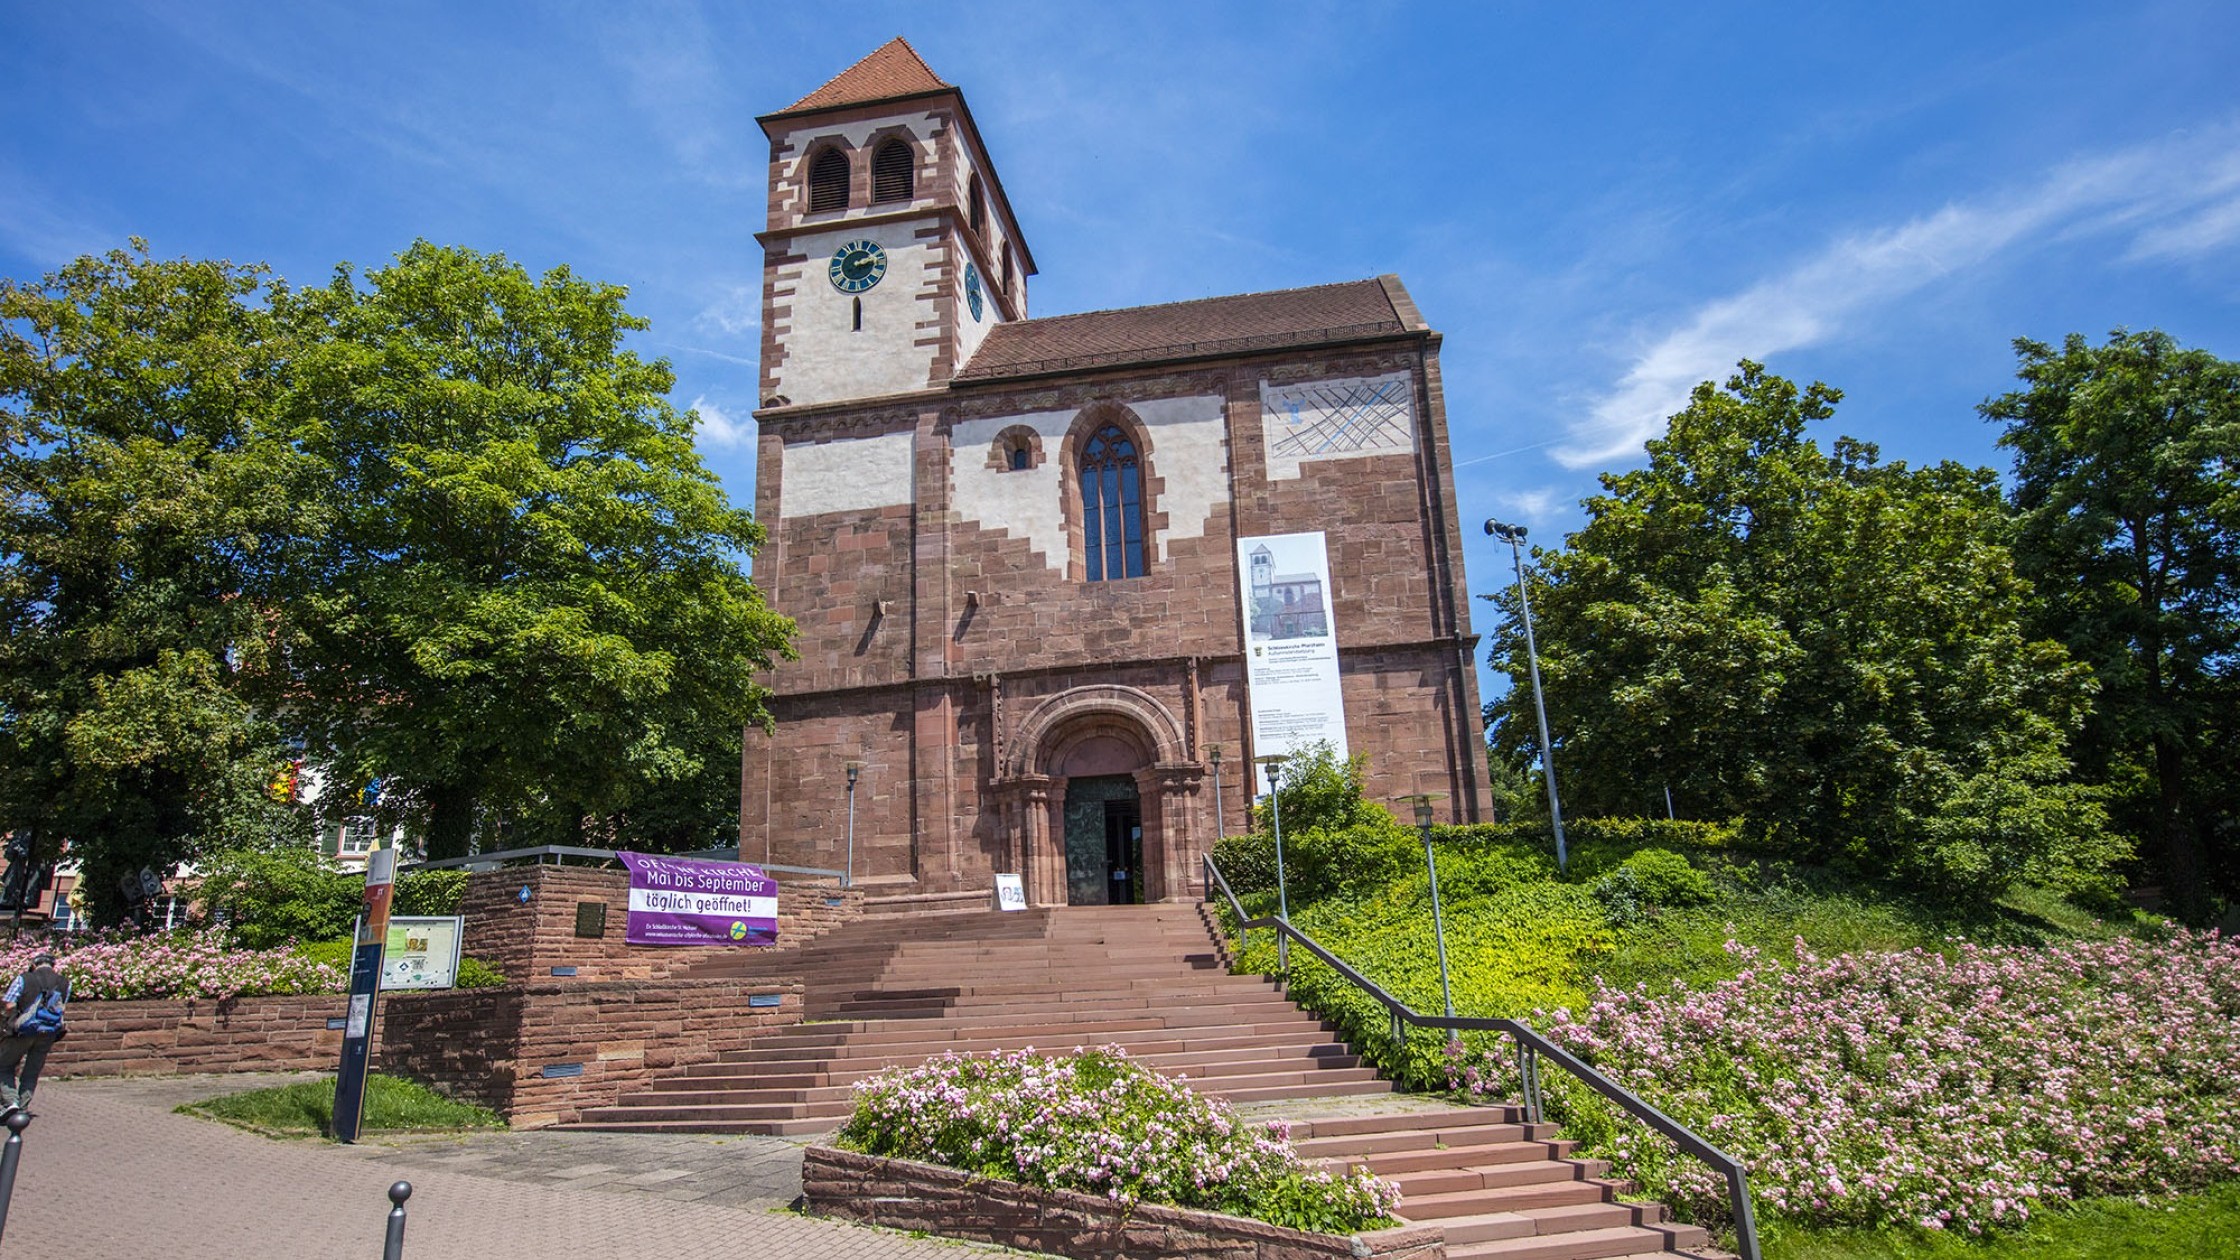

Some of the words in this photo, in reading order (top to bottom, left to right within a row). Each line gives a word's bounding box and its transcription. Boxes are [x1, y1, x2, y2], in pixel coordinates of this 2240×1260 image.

[647, 871, 672, 885] Mai
[675, 873, 695, 888] bis
[698, 875, 765, 892] September
[701, 868, 760, 876] KIRCHE
[646, 893, 692, 912] täglich
[696, 896, 752, 913] geöffnet!
